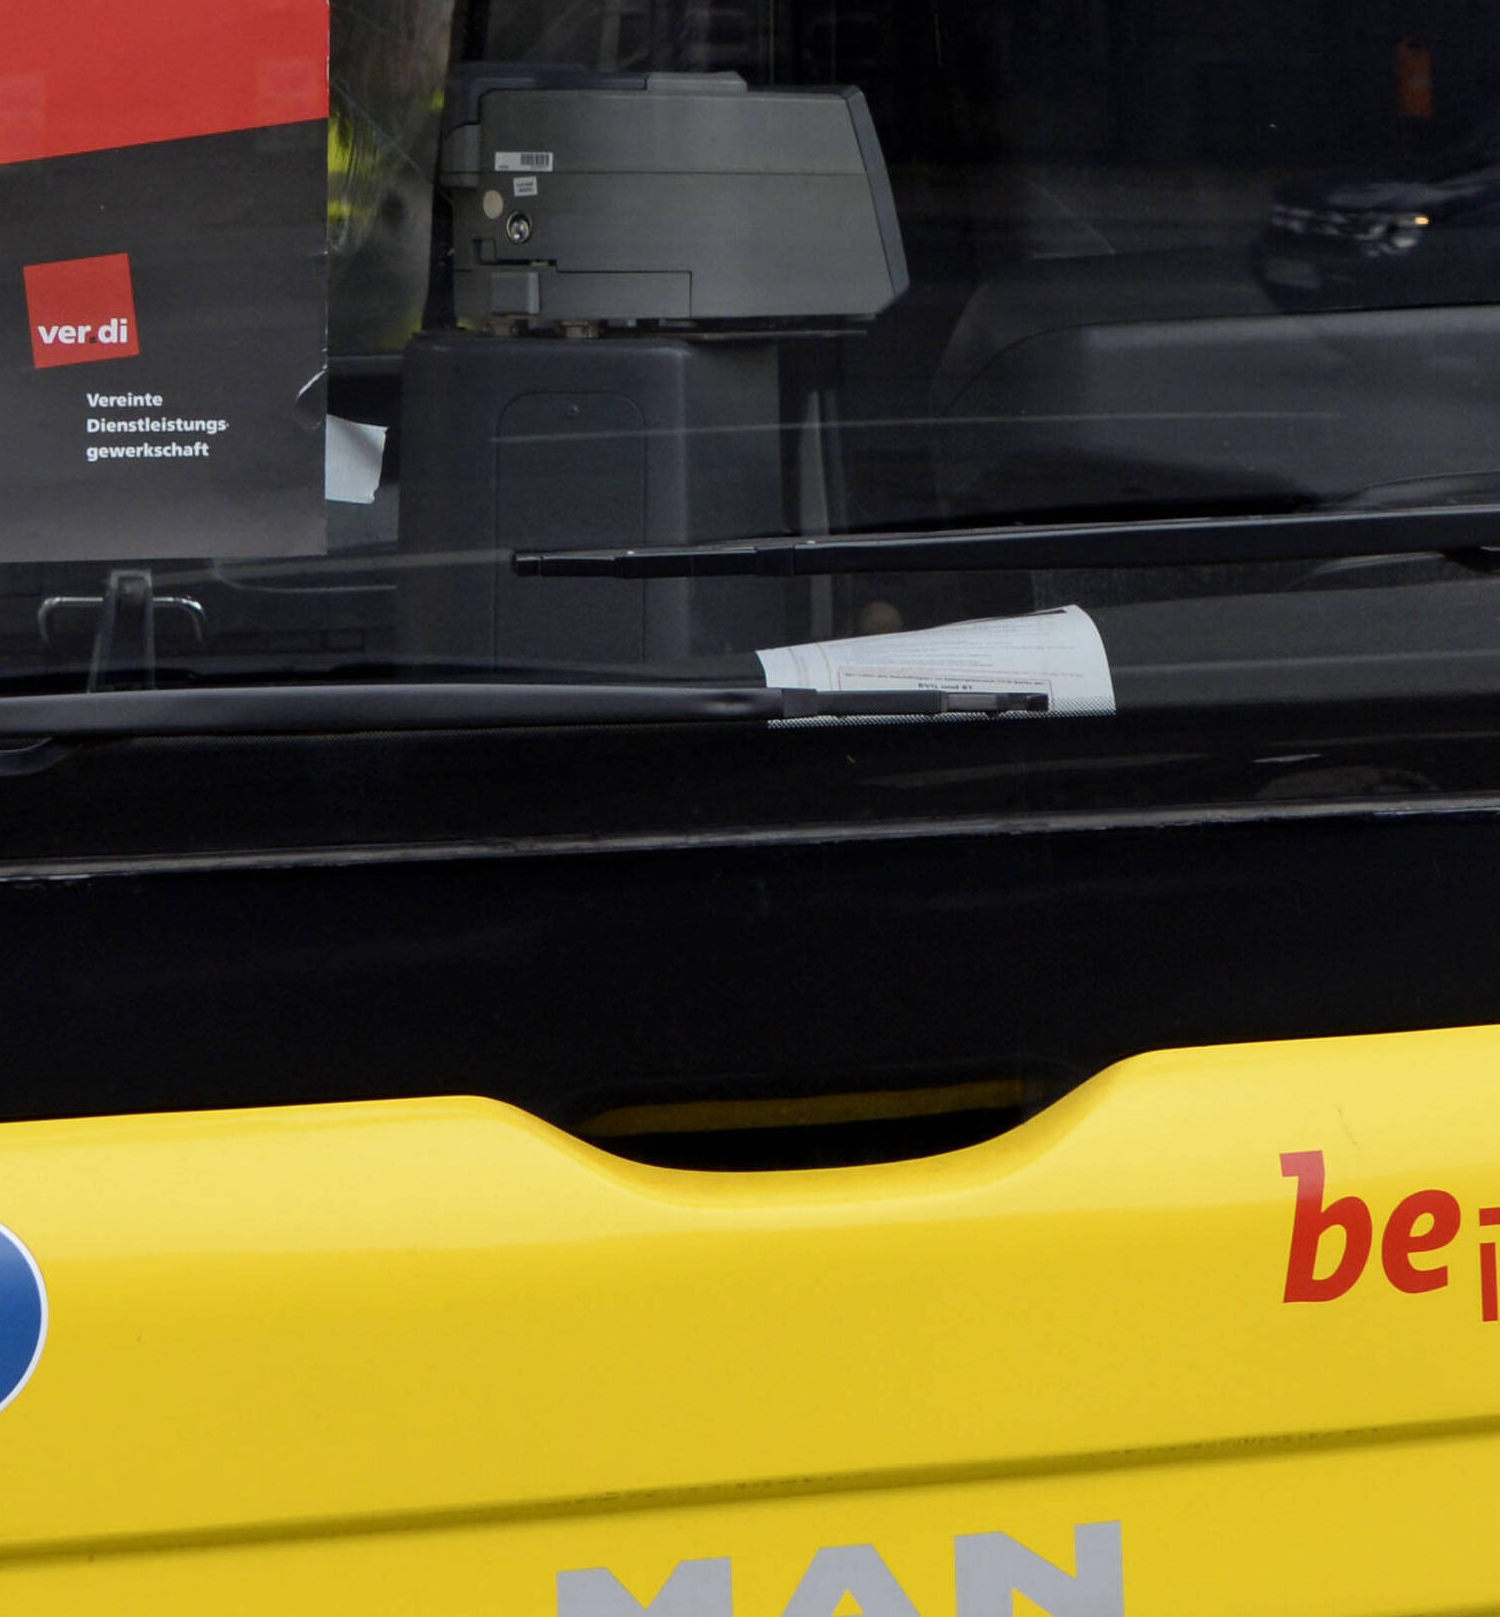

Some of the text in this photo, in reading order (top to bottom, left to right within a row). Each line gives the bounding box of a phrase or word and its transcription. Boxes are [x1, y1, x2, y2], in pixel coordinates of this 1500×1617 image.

[86, 392, 163, 408] Vereinte
[86, 442, 210, 462] gewerkschaft
[1280, 1149, 1461, 1304] be
